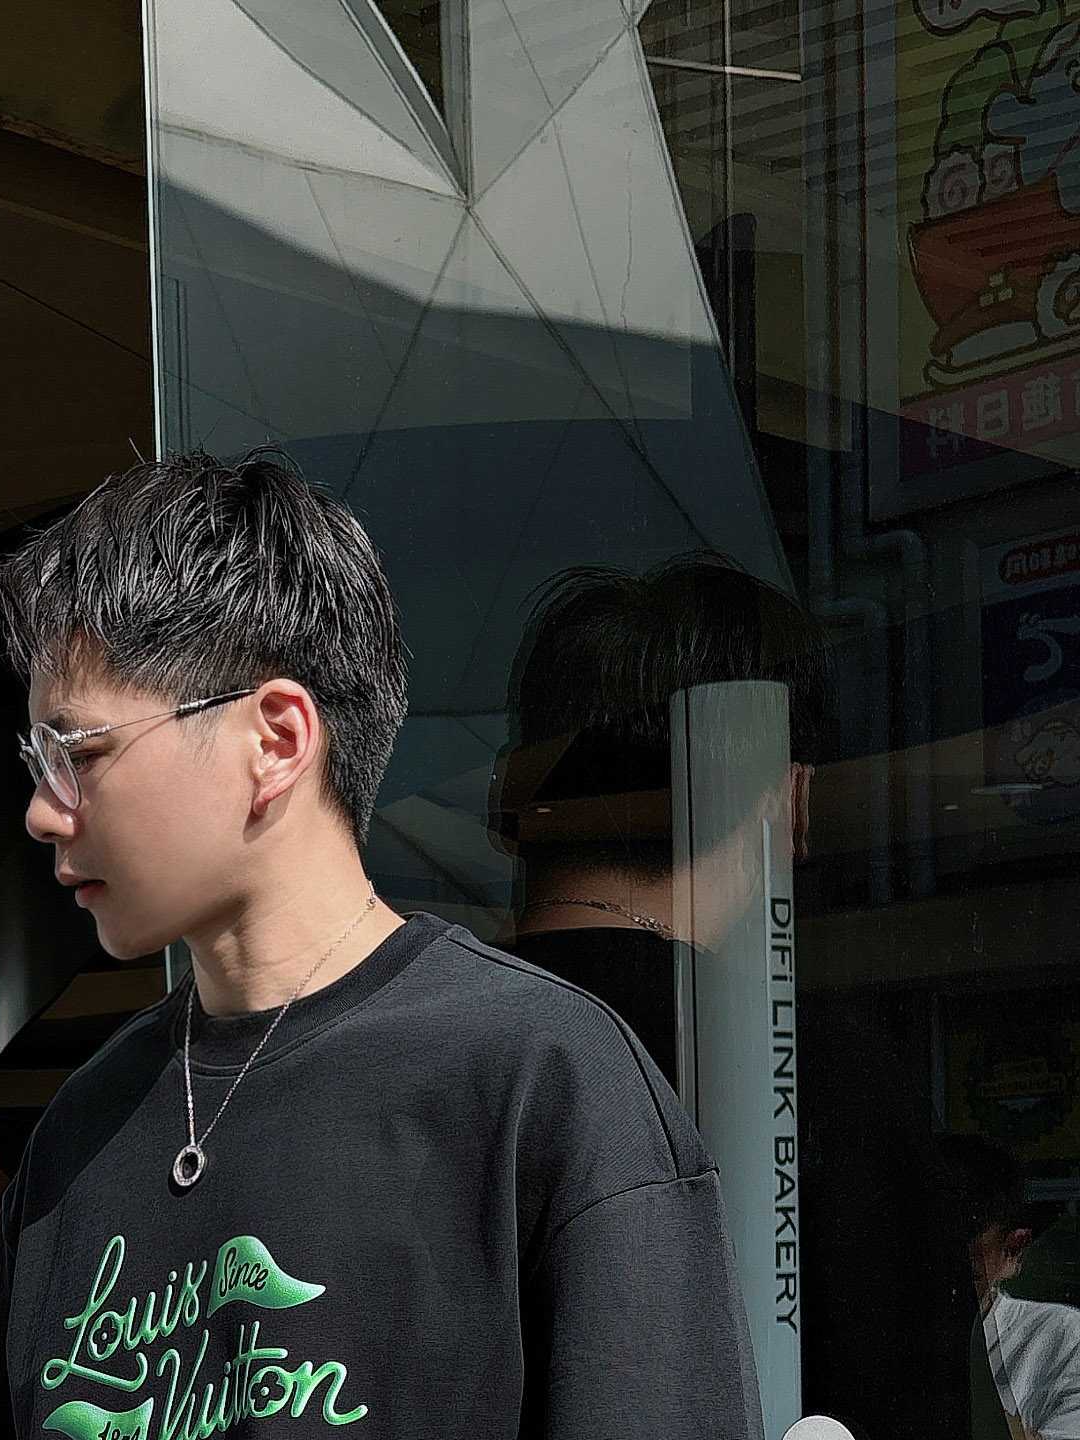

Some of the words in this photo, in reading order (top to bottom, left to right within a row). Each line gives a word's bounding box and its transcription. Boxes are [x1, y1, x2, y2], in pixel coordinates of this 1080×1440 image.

[770, 896, 794, 982] DiFi
[772, 999, 796, 1121] LINK
[219, 1247, 269, 1298] Since
[773, 1135, 799, 1335] BAKERY
[40, 1235, 209, 1391] Louis
